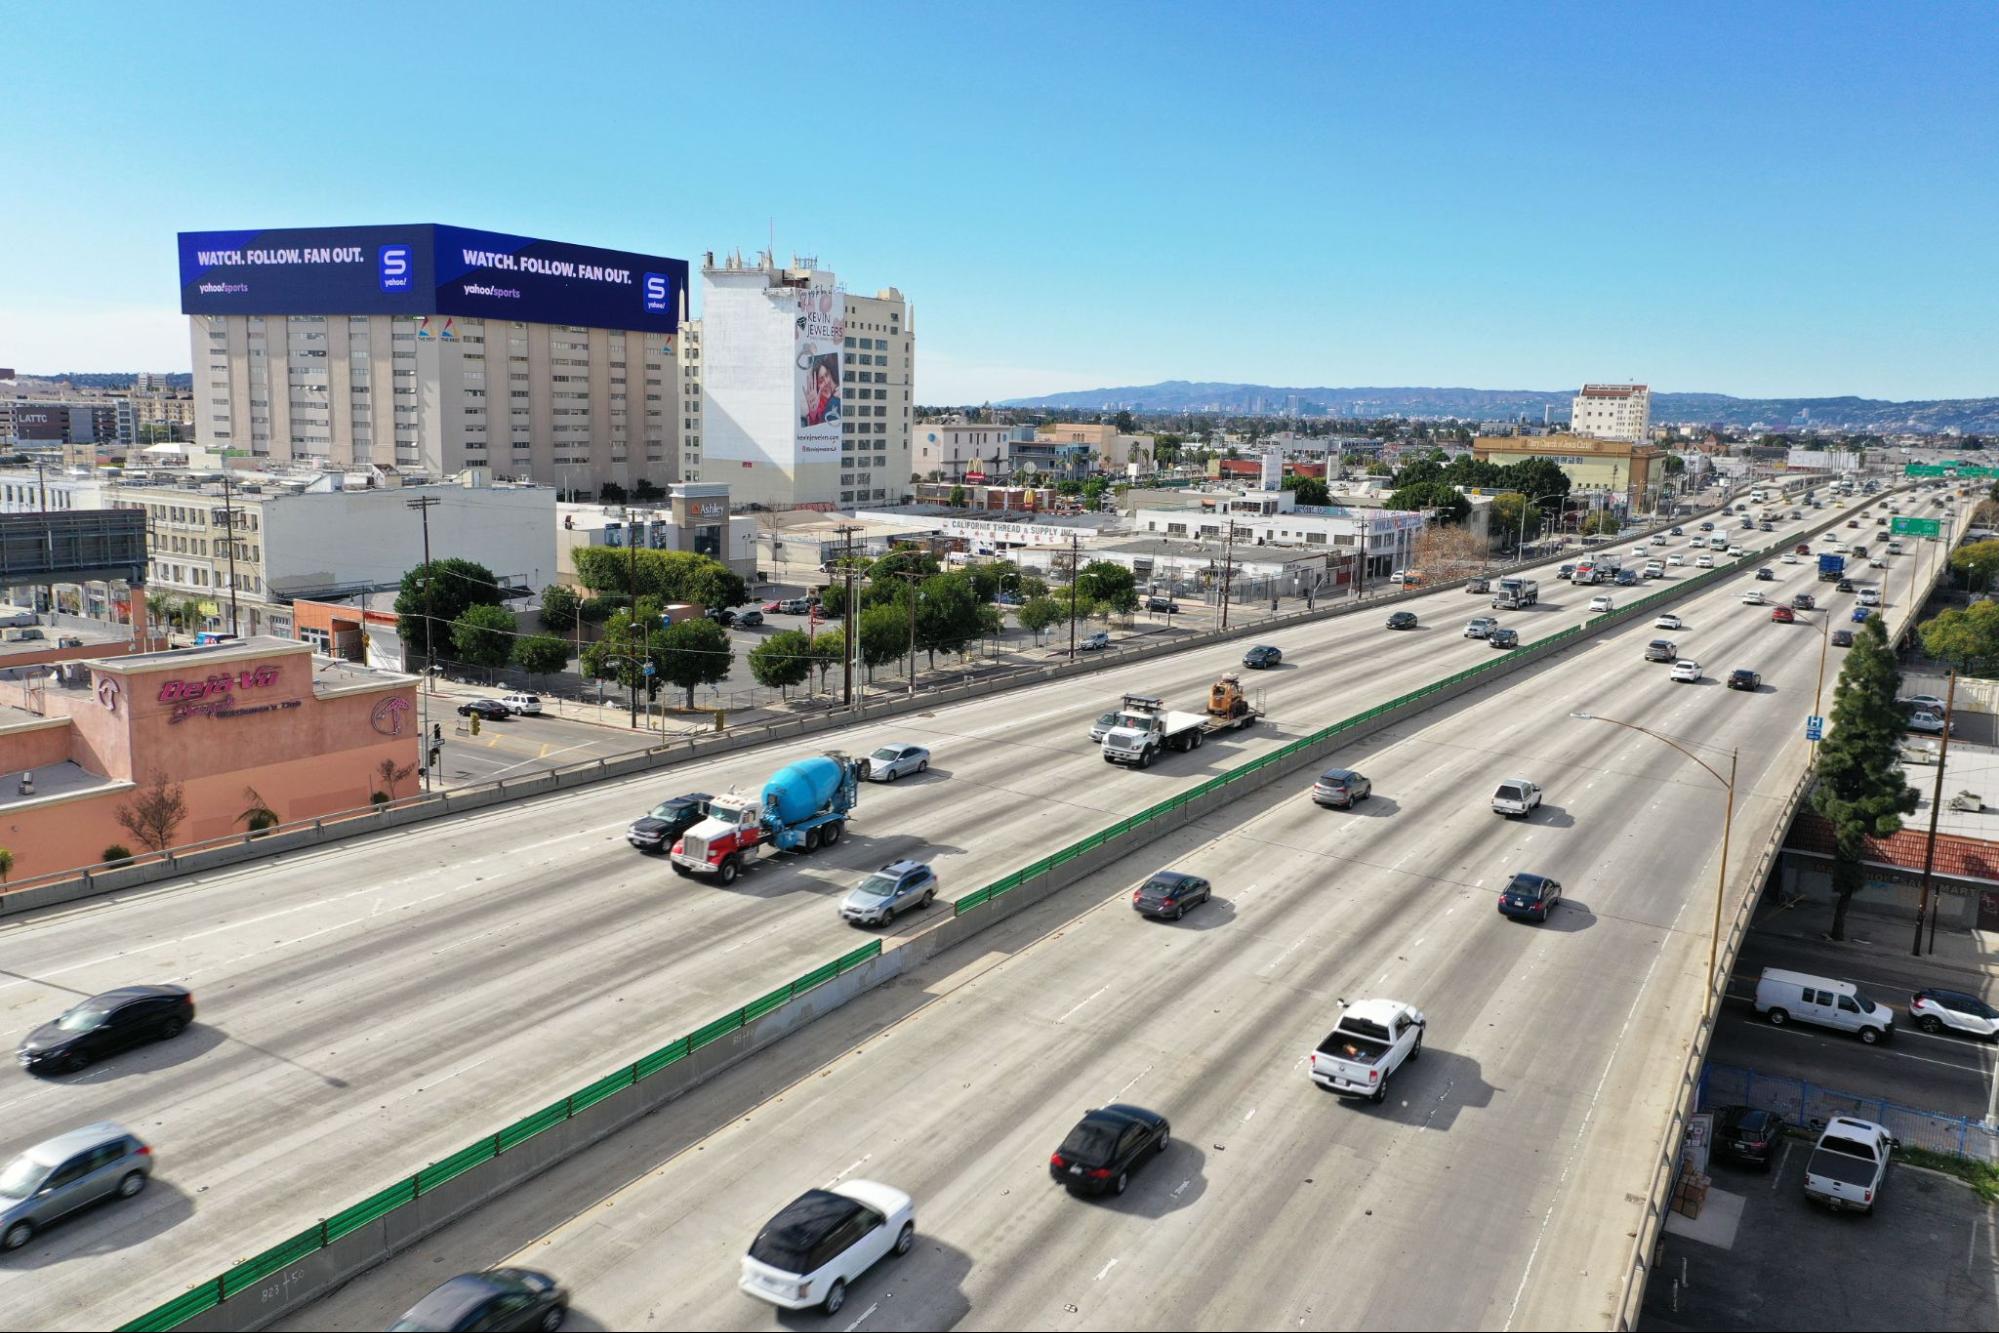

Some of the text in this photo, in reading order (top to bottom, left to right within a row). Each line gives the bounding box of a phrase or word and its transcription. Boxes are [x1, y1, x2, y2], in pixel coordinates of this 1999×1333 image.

[198, 248, 364, 266] WATCH. FOLLOW. FAN OUT.
[463, 249, 632, 285] WATCH. FOLLOW. FAN OUT.
[384, 277, 406, 287] yahoo!
[807, 311, 831, 324] KEVIN
[806, 323, 844, 338] JEWELERS
[18, 414, 47, 423] LATTC
[700, 502, 724, 516] Ashley
[952, 520, 990, 531] CALIFORNIA
[993, 522, 1021, 533] THREAD
[1031, 526, 1058, 536] SUPPLY
